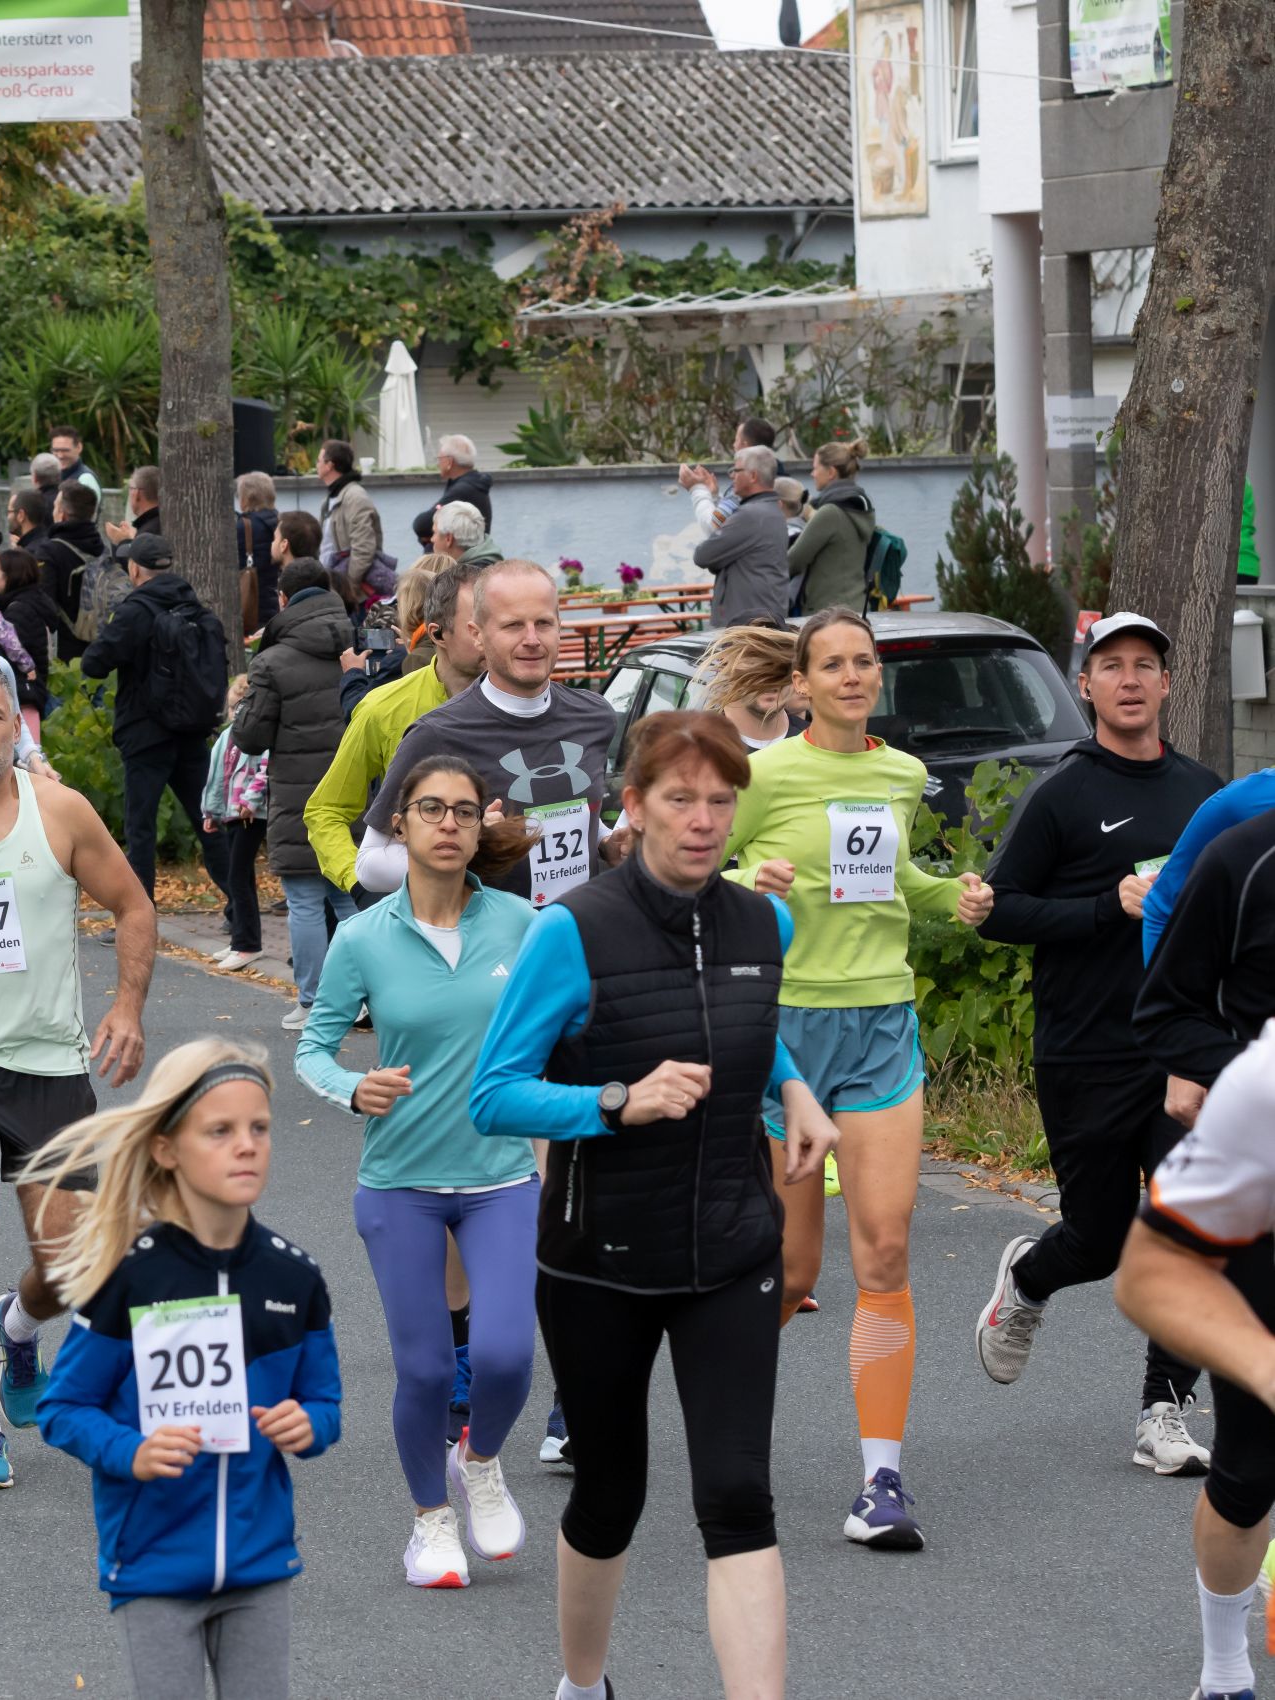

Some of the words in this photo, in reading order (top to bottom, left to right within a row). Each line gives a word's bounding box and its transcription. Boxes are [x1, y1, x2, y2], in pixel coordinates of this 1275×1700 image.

[67, 34, 93, 44] von
[544, 806, 583, 819] KühkopfLauf
[845, 805, 885, 813] KühkopfLauf
[535, 828, 583, 864] 132
[846, 825, 882, 856] 67
[534, 872, 548, 882] TV
[550, 864, 587, 880] Erfelden
[833, 864, 846, 875] TV
[849, 863, 892, 875] Erfelden
[265, 1299, 297, 1314] Robert
[148, 1342, 232, 1392] 203
[145, 1404, 168, 1418] TV
[173, 1401, 242, 1417] Erfelden
